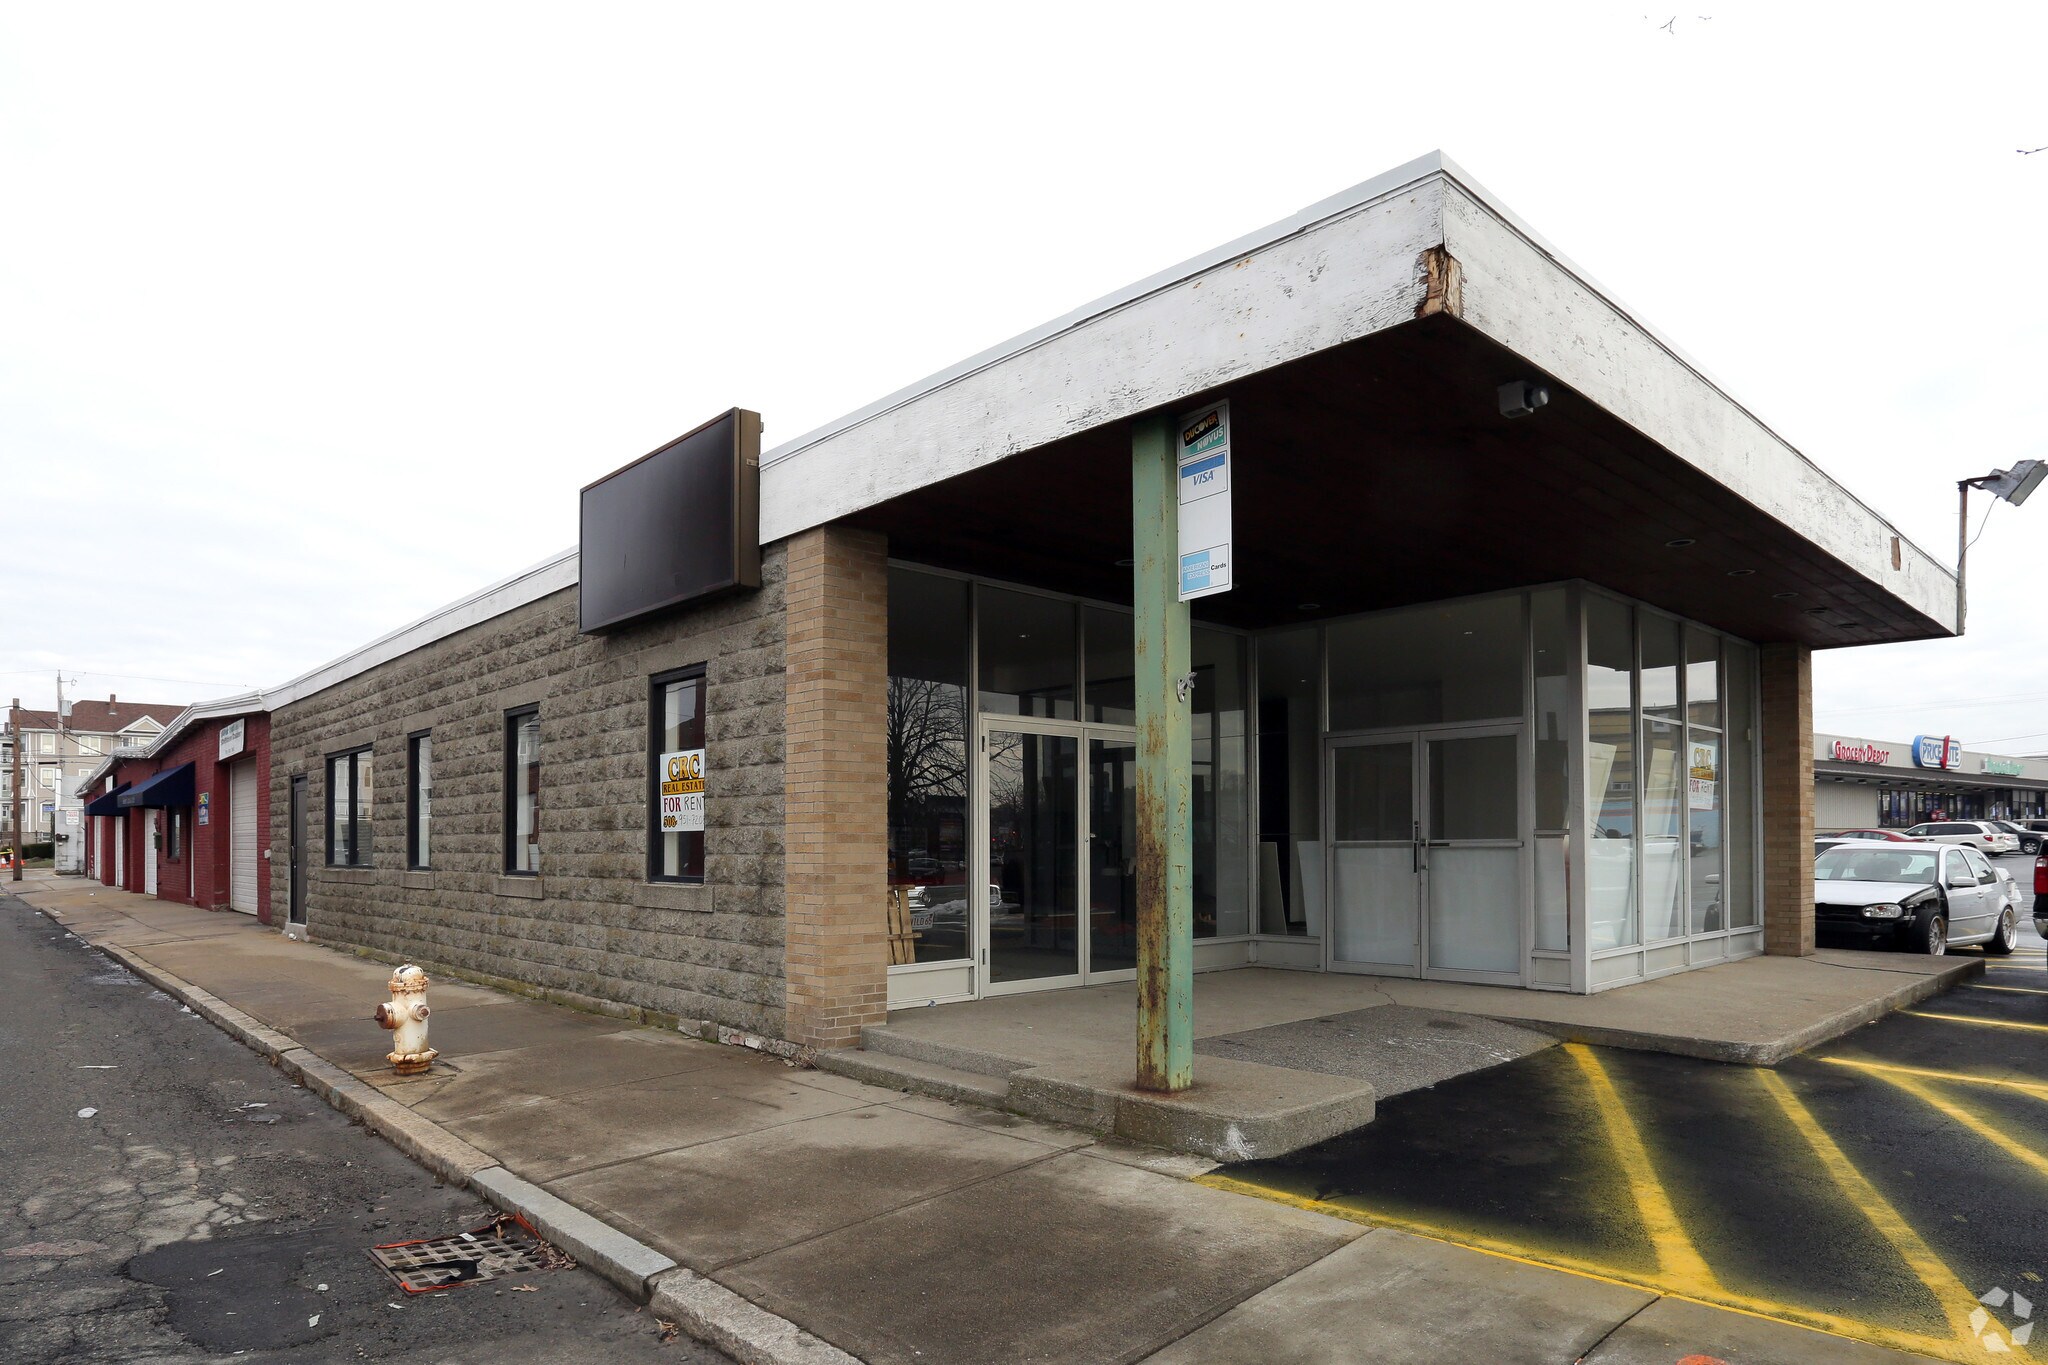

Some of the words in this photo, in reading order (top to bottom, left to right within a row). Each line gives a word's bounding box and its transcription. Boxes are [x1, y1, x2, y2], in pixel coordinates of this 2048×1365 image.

[1197, 427, 1224, 451] NOVUS
[1193, 470, 1214, 486] VISA
[1210, 562, 1227, 571] Cards
[1867, 744, 1890, 764] DEPOT
[1922, 742, 1942, 760] PRICE
[669, 754, 700, 781] CRC
[664, 784, 679, 793] REAL
[664, 797, 681, 812] FOR
